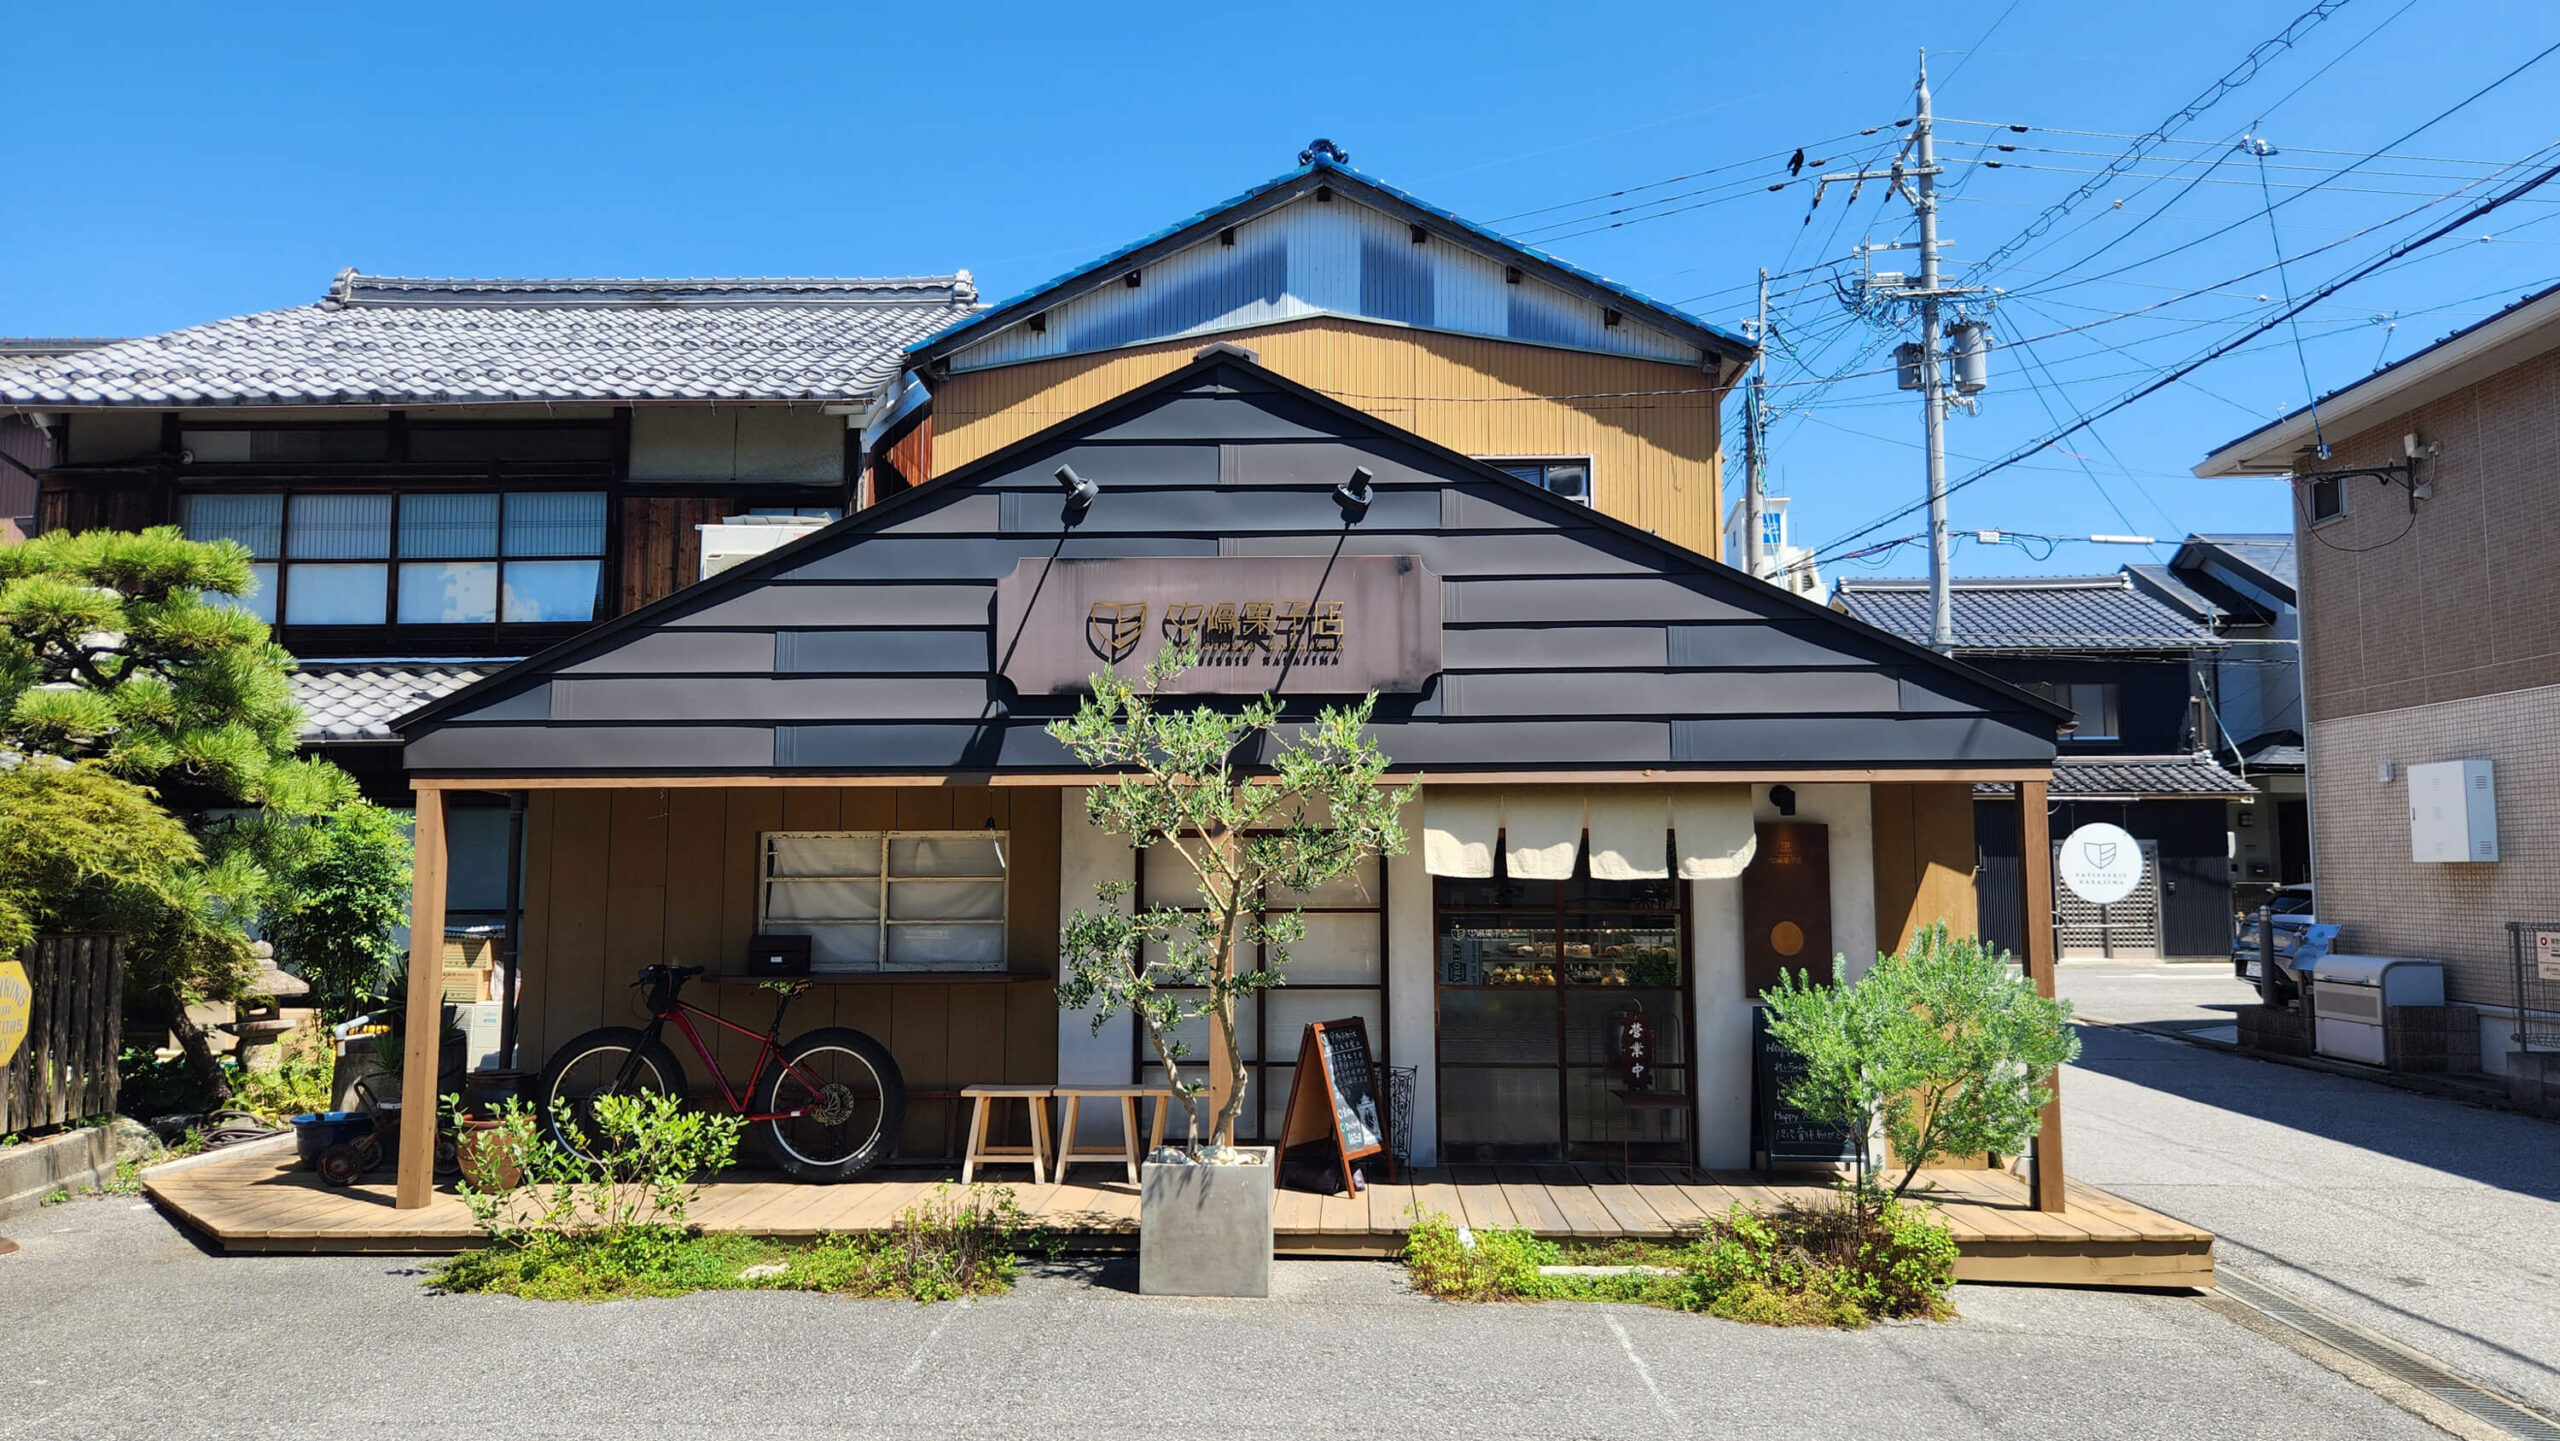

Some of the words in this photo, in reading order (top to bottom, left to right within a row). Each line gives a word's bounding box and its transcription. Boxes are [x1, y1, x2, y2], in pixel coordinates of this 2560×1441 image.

[1167, 600, 1345, 636] 中嶋菓子店
